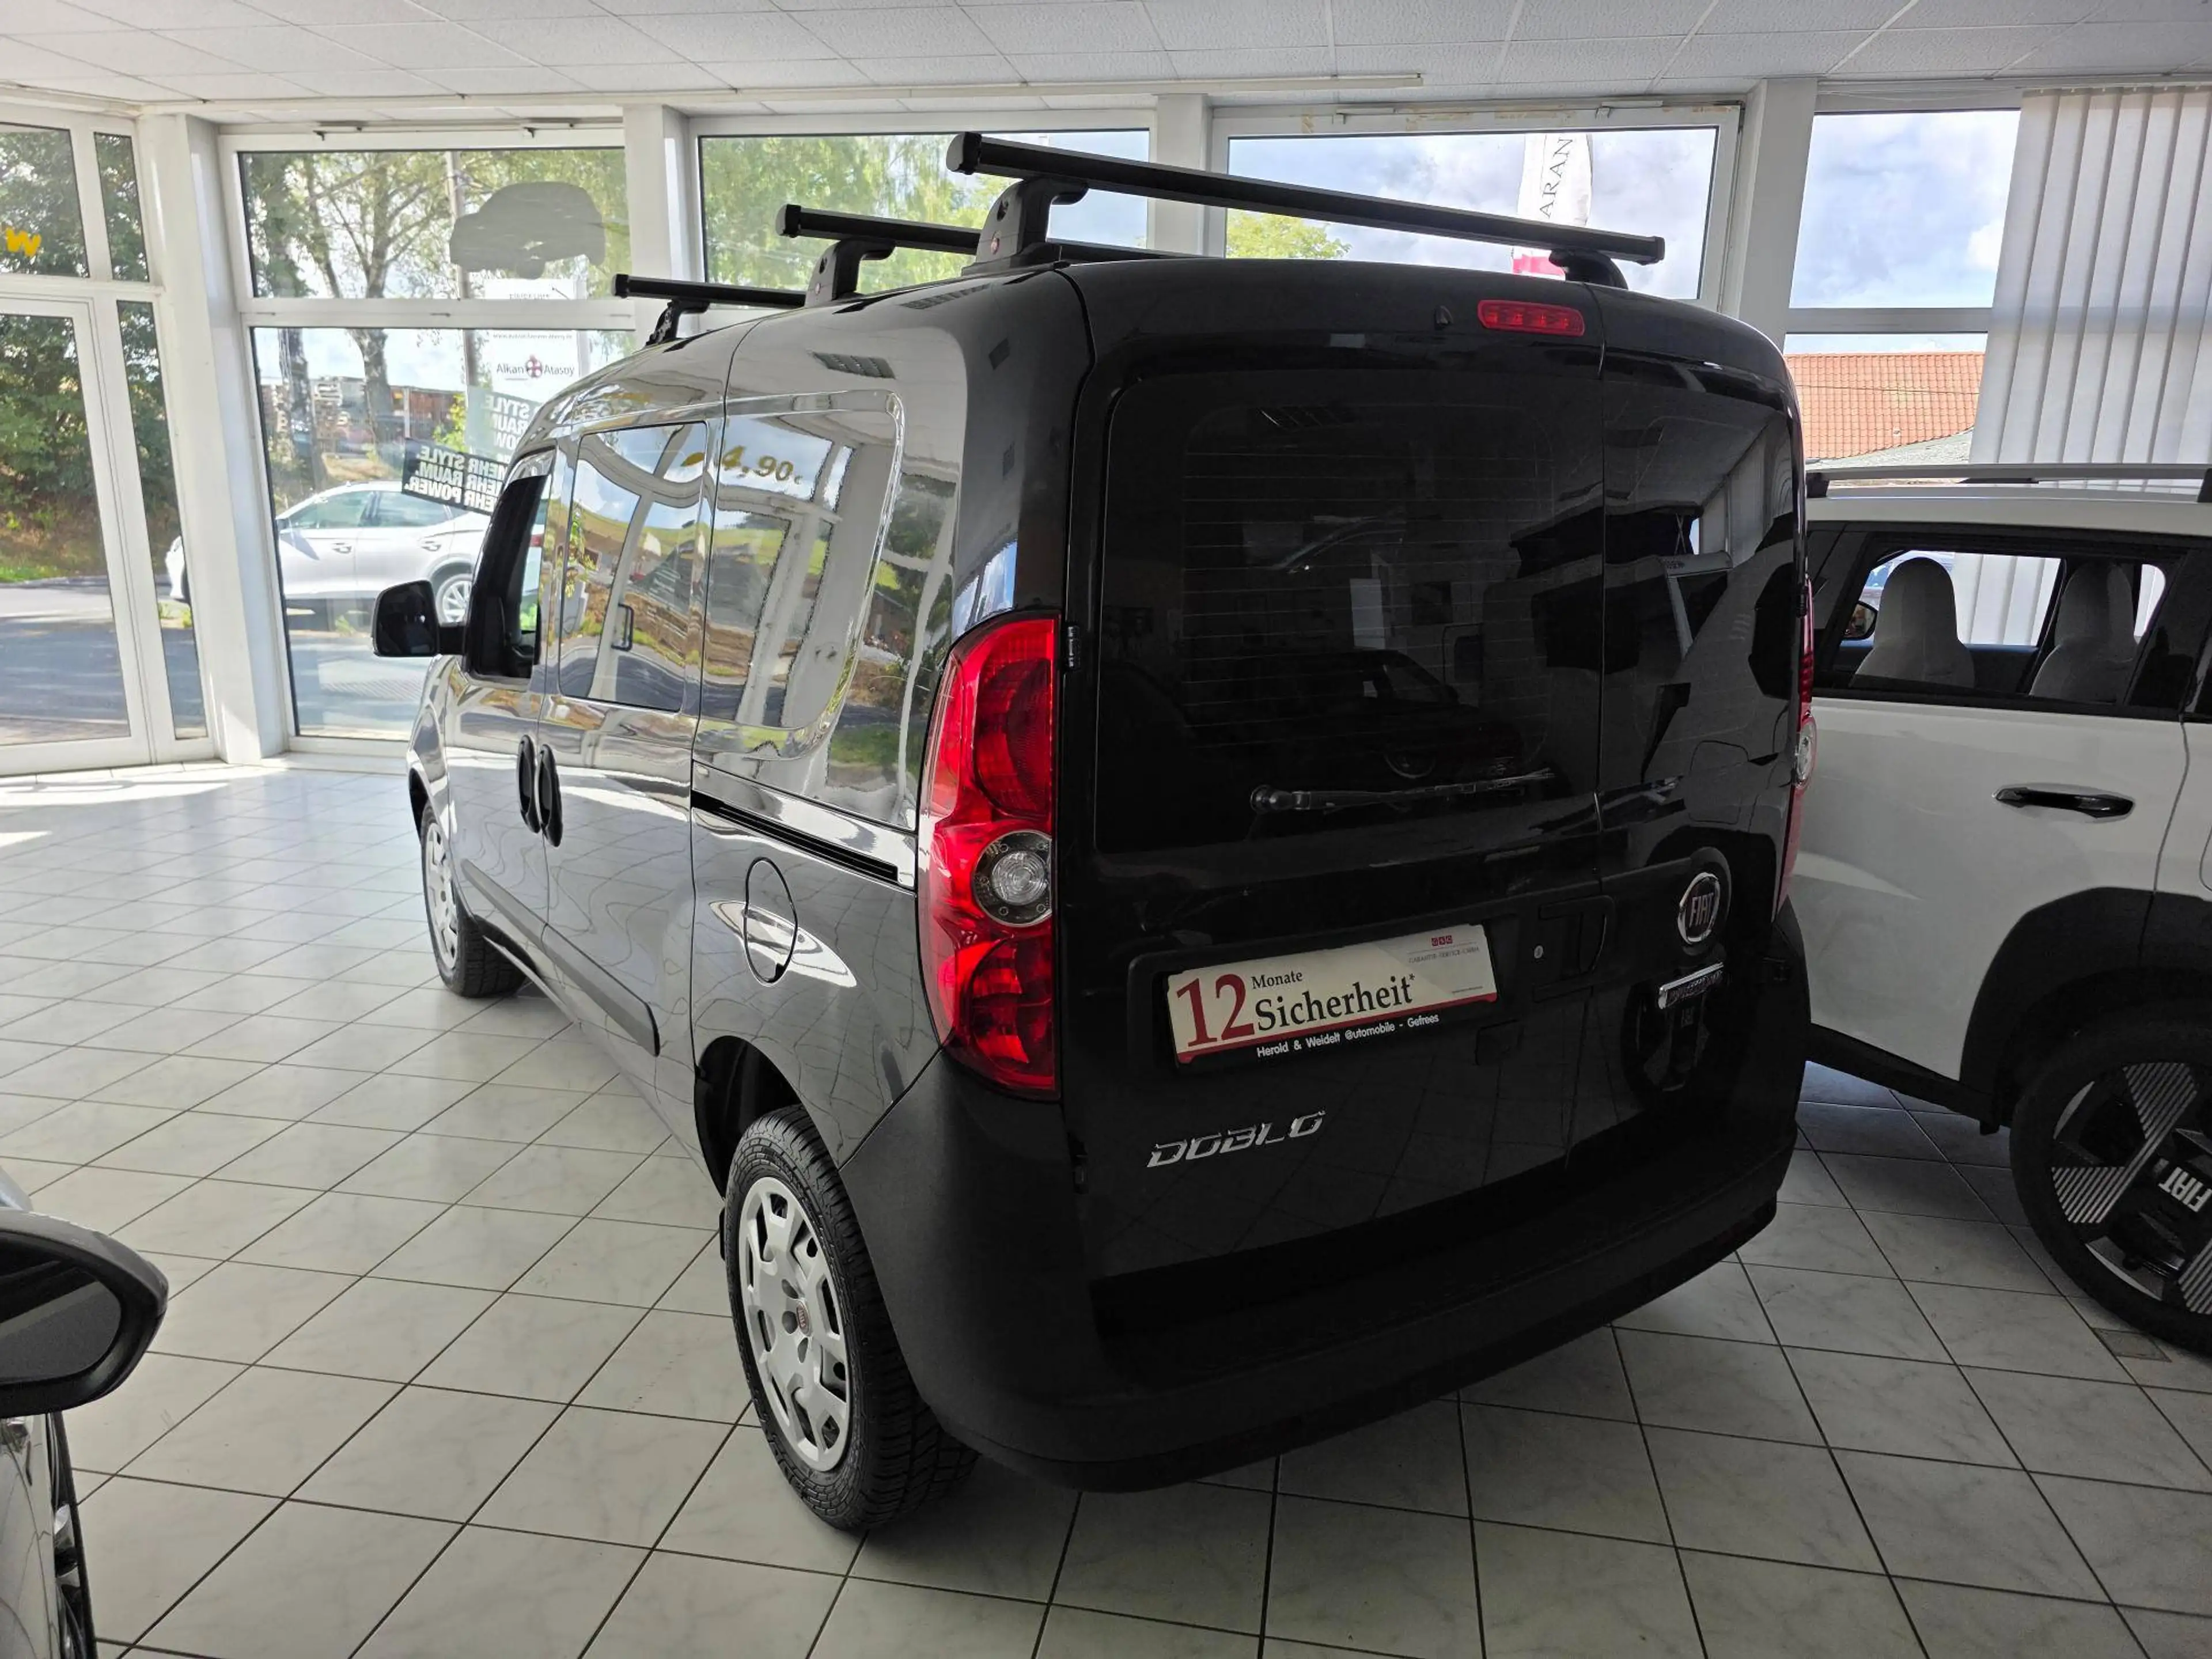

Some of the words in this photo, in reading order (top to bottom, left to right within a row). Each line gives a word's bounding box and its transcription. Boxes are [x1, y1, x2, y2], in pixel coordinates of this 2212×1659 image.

[496, 363, 524, 374] Alkan
[1689, 893, 1714, 927] FIAT
[1252, 970, 1303, 990] Monate
[1176, 973, 1255, 1047] 12
[1256, 1041, 1289, 1058] Herold
[1293, 1040, 1302, 1051] &
[1306, 1032, 1341, 1048] Weidelt
[1407, 1014, 1439, 1028] Gefrees
[2158, 1166, 2212, 1213] FIAT
